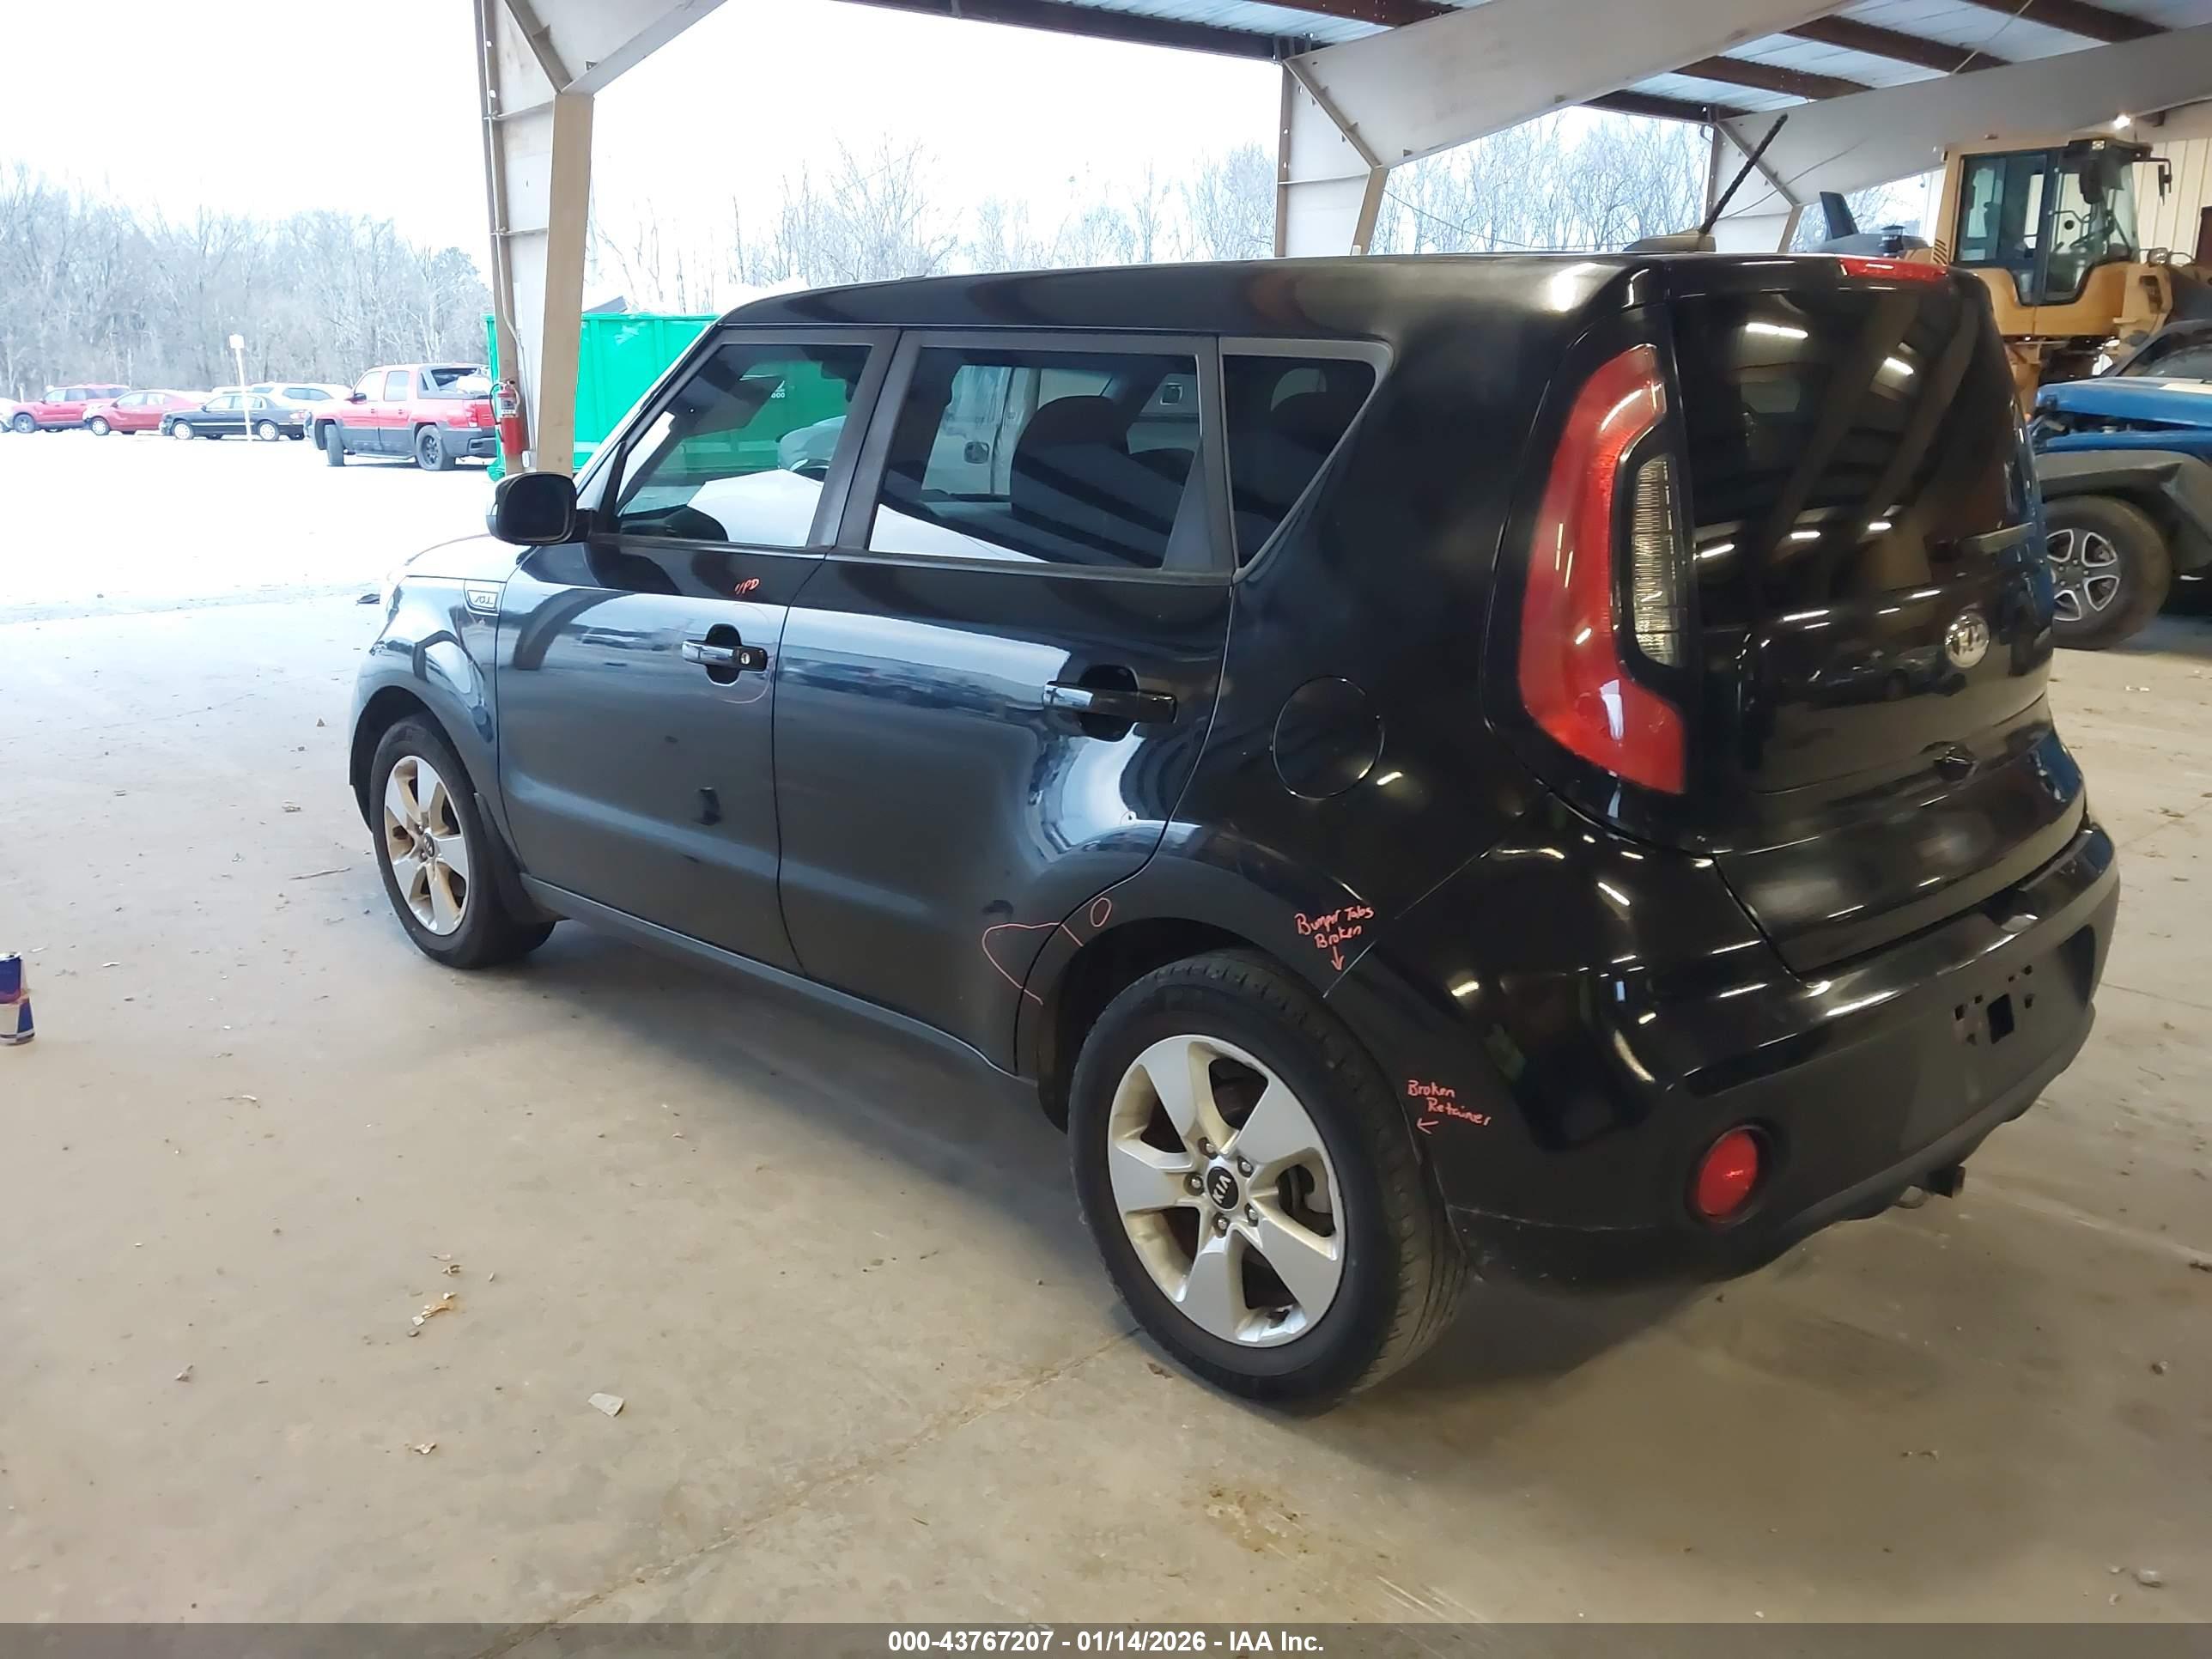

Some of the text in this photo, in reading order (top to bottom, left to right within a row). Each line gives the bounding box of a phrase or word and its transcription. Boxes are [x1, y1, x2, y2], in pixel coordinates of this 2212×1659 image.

[1344, 904, 1375, 921] Tabs
[1314, 925, 1362, 949] Broken
[1407, 1079, 1455, 1098] Broken
[1426, 1097, 1492, 1126] Retainer
[1212, 1175, 1232, 1204] KIA
